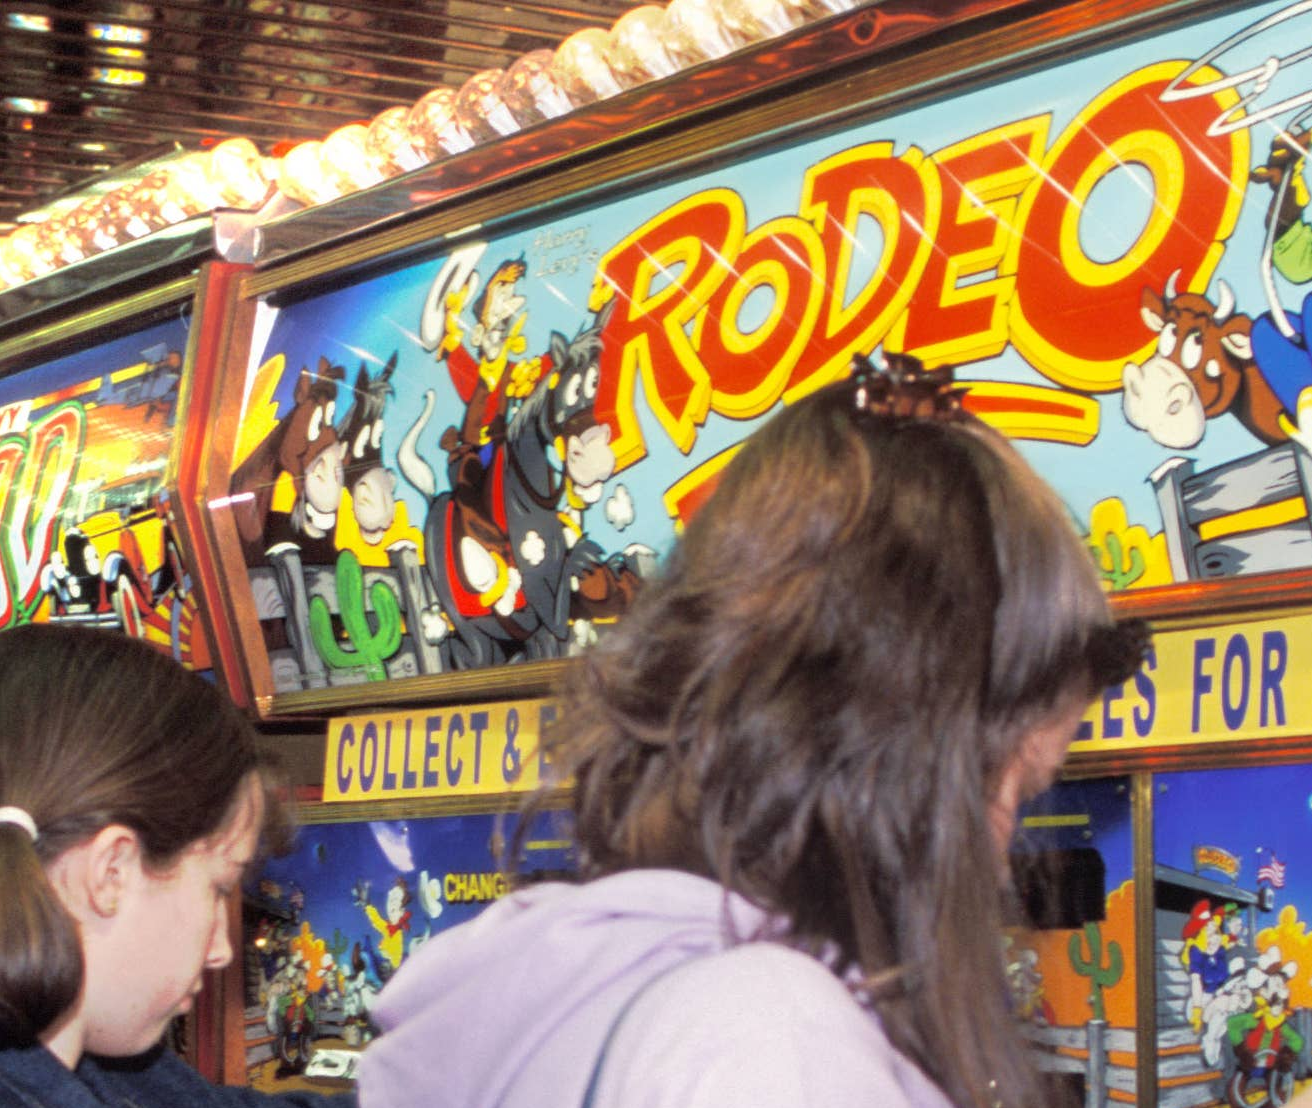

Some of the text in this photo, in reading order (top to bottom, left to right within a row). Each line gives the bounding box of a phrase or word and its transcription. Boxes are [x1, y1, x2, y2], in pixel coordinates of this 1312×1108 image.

[590, 60, 1251, 473] RODEO
[1192, 631, 1288, 733] FOR
[336, 711, 489, 794] COLLECT
[502, 708, 520, 784] &
